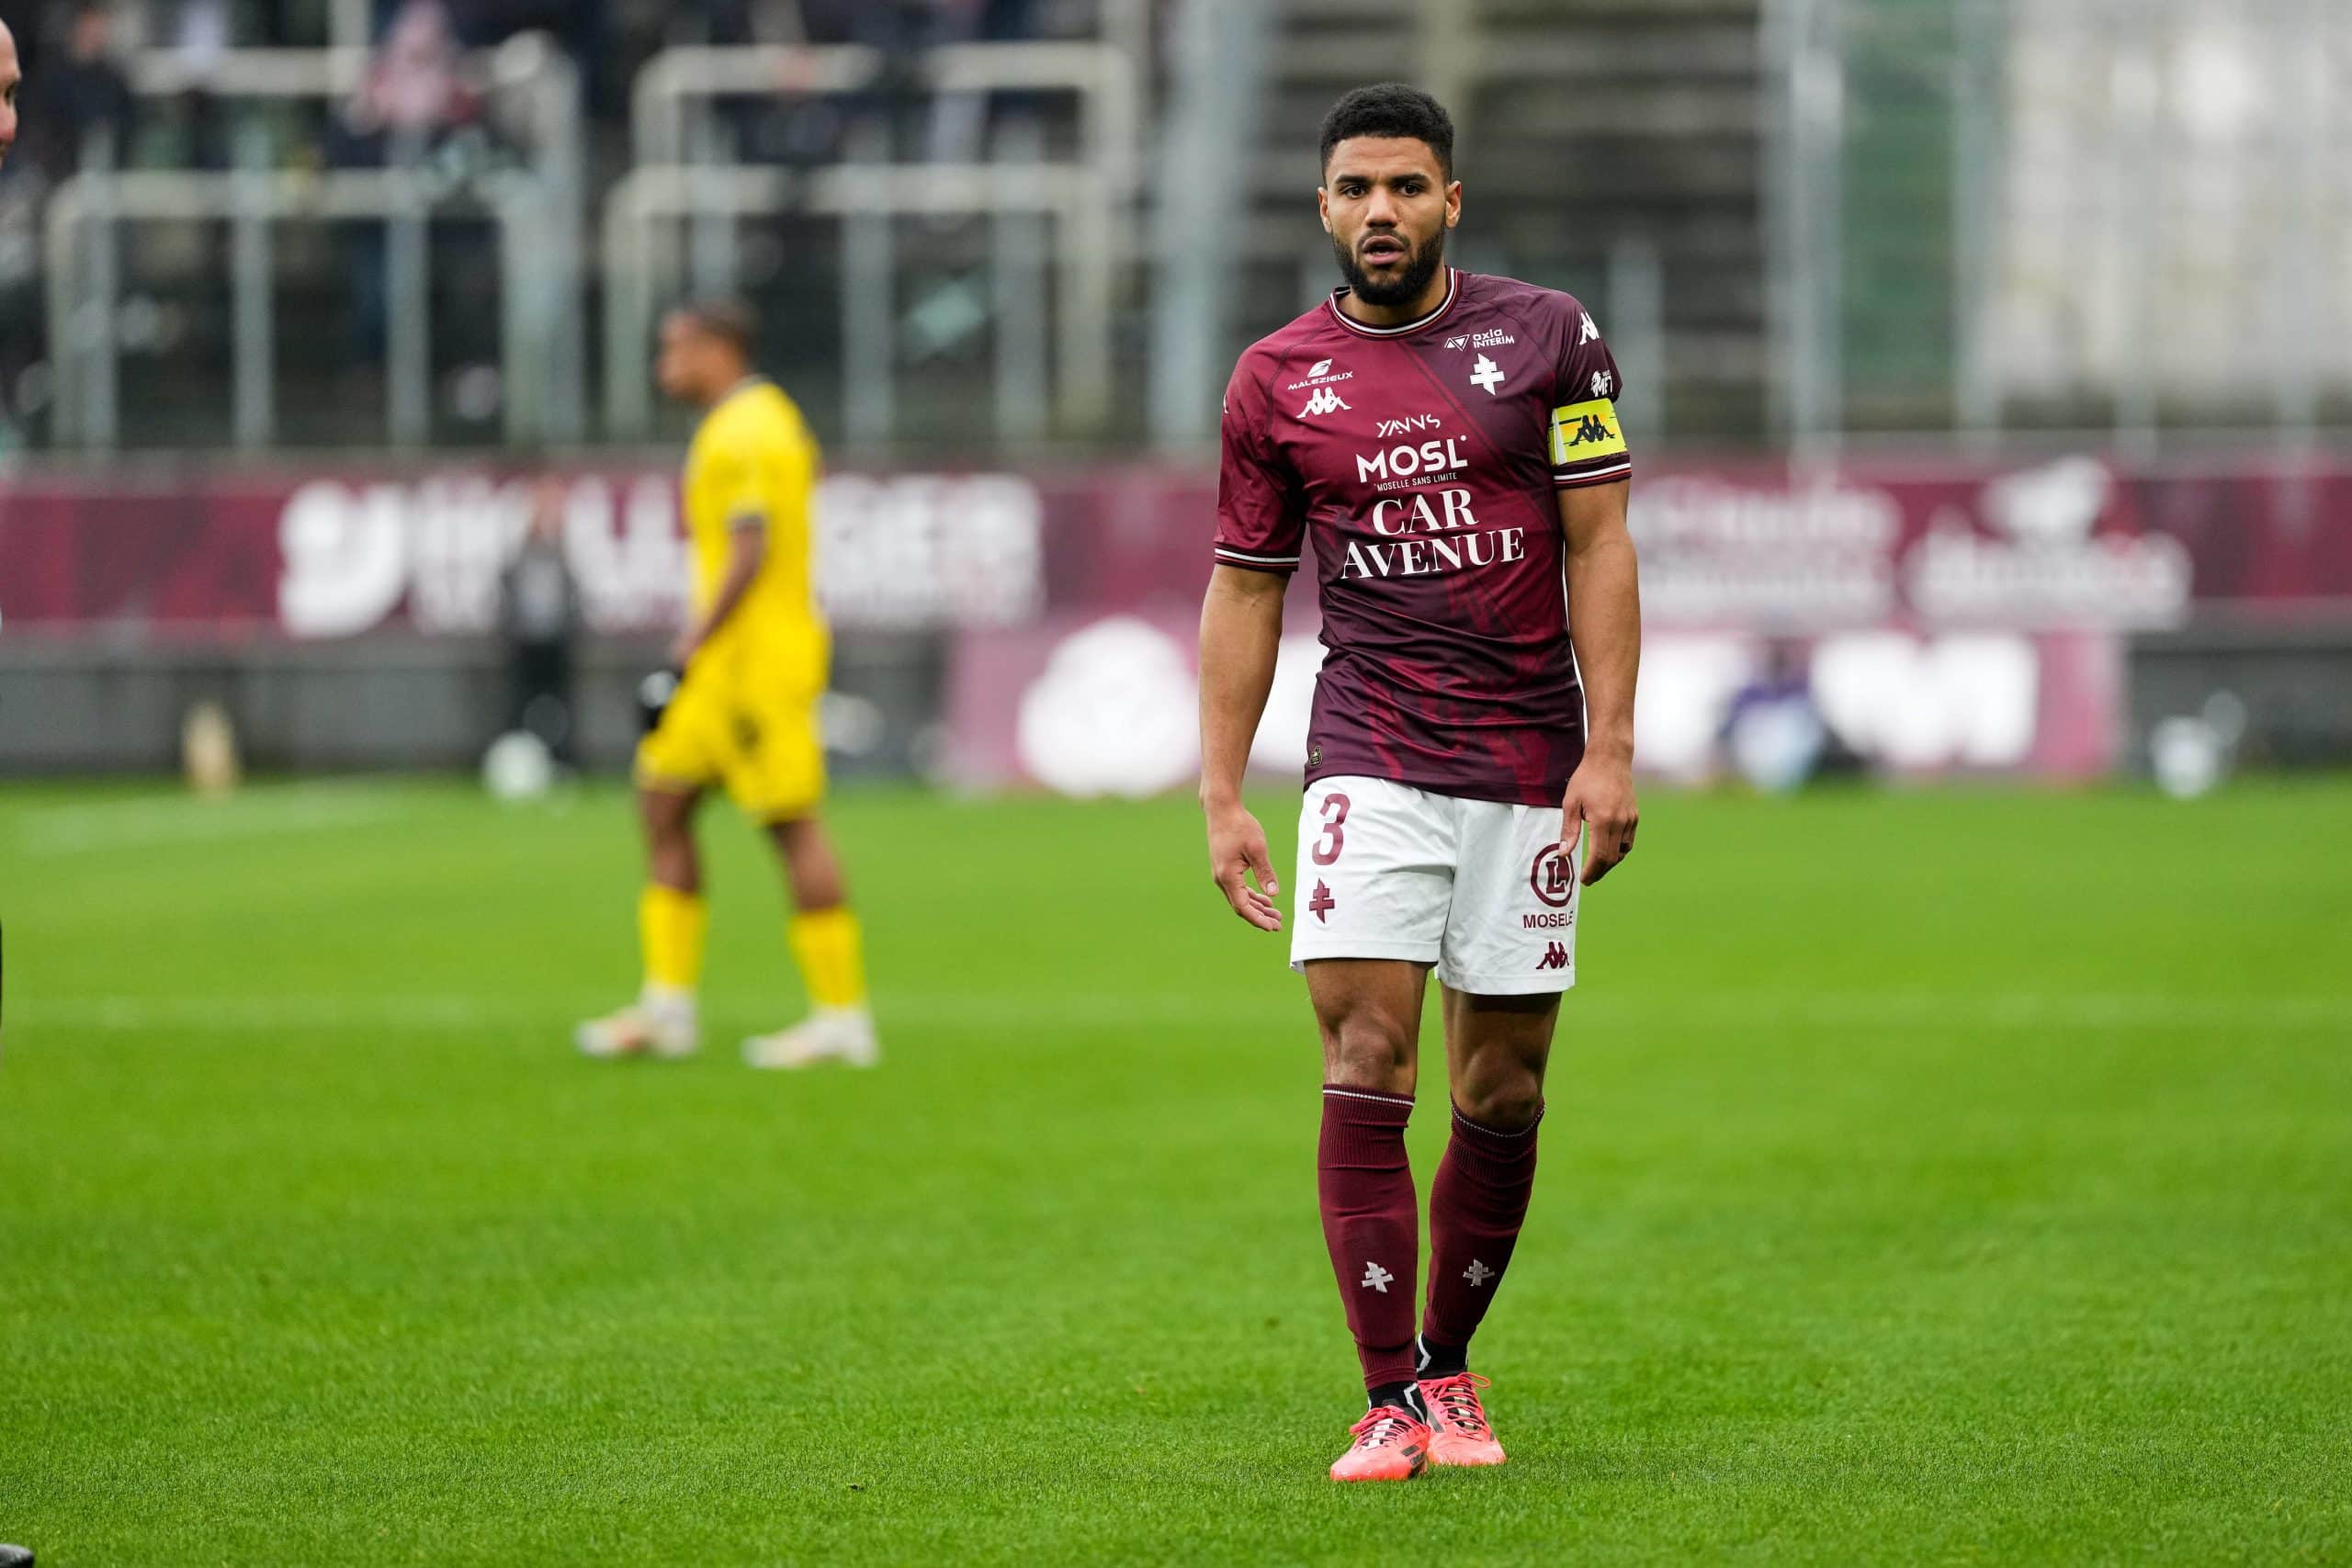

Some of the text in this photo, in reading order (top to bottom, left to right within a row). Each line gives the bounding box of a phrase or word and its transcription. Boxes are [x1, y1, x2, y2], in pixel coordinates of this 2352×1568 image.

[1473, 335, 1515, 349] INTERIM
[1412, 475, 1433, 486] SANS
[1433, 472, 1458, 483] LIMITE
[1373, 489, 1479, 536] CAR
[1340, 527, 1525, 580] AVENUE
[1312, 793, 1351, 866] 3
